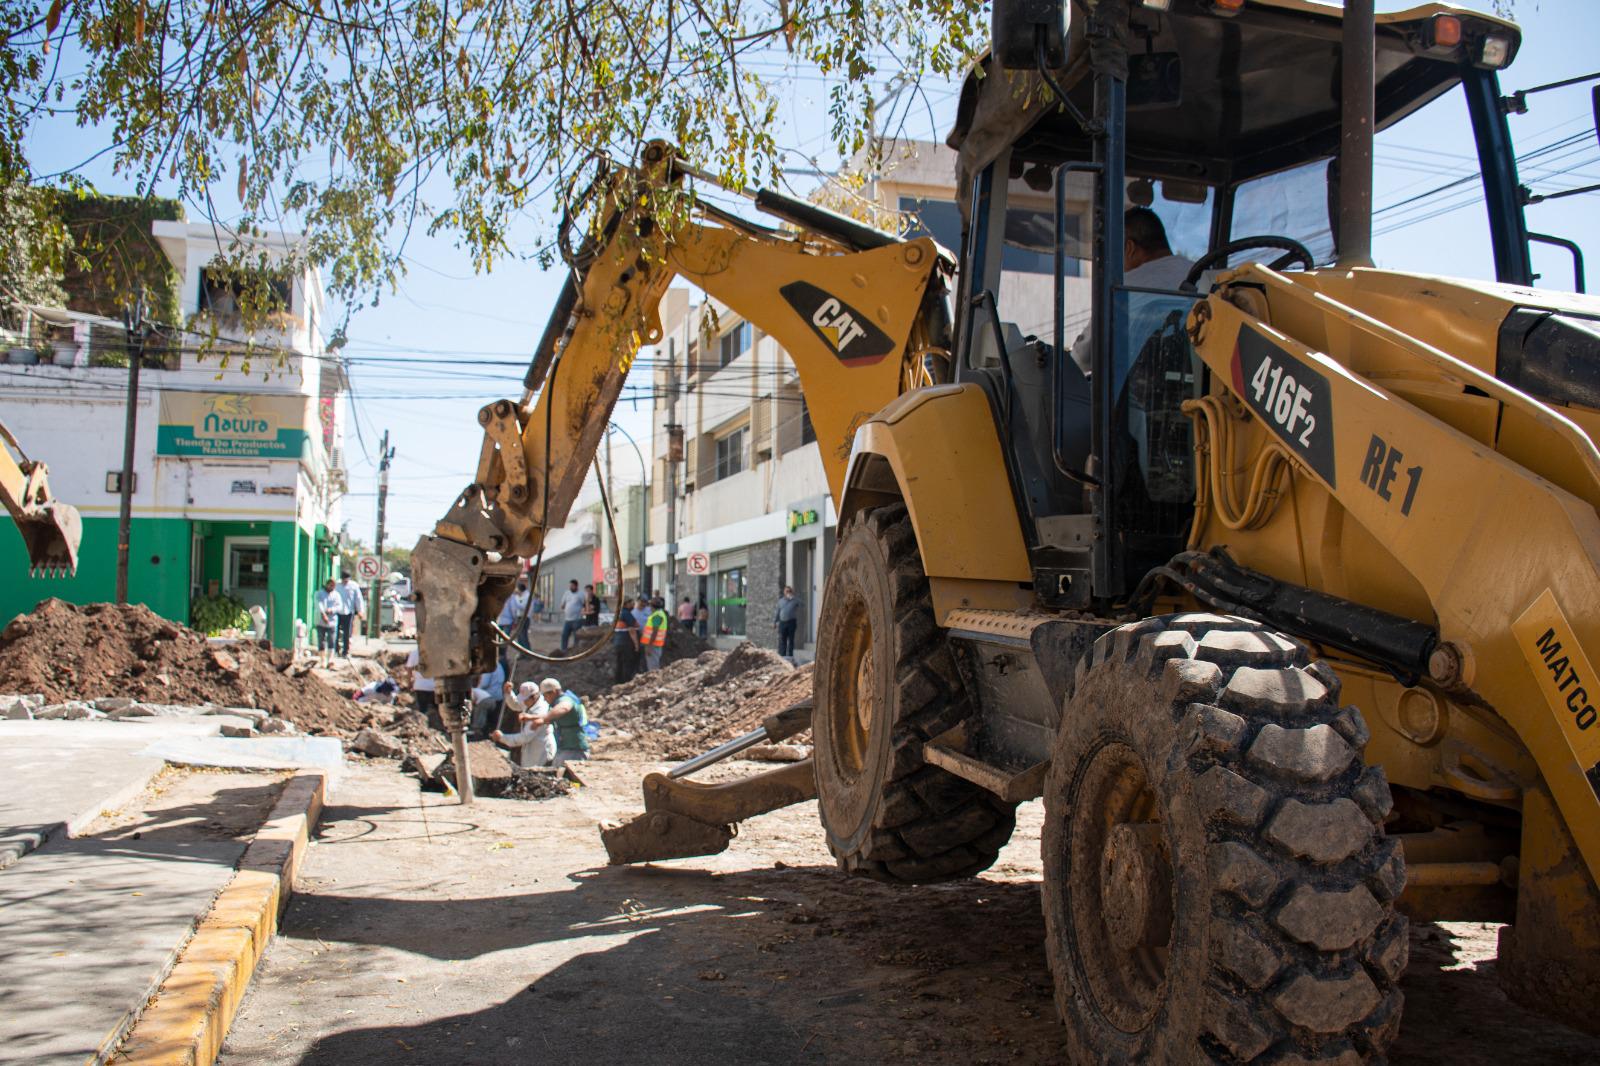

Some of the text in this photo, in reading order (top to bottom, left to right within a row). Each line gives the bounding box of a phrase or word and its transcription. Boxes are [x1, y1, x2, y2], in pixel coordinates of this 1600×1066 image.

[812, 298, 865, 352] CAT
[1251, 355, 1316, 449] 416F2
[175, 438, 211, 449] Tienda
[231, 439, 286, 450] Productos
[202, 446, 259, 456] Naturistas
[1360, 433, 1423, 518] RE 1
[1535, 627, 1598, 731] MATCO
